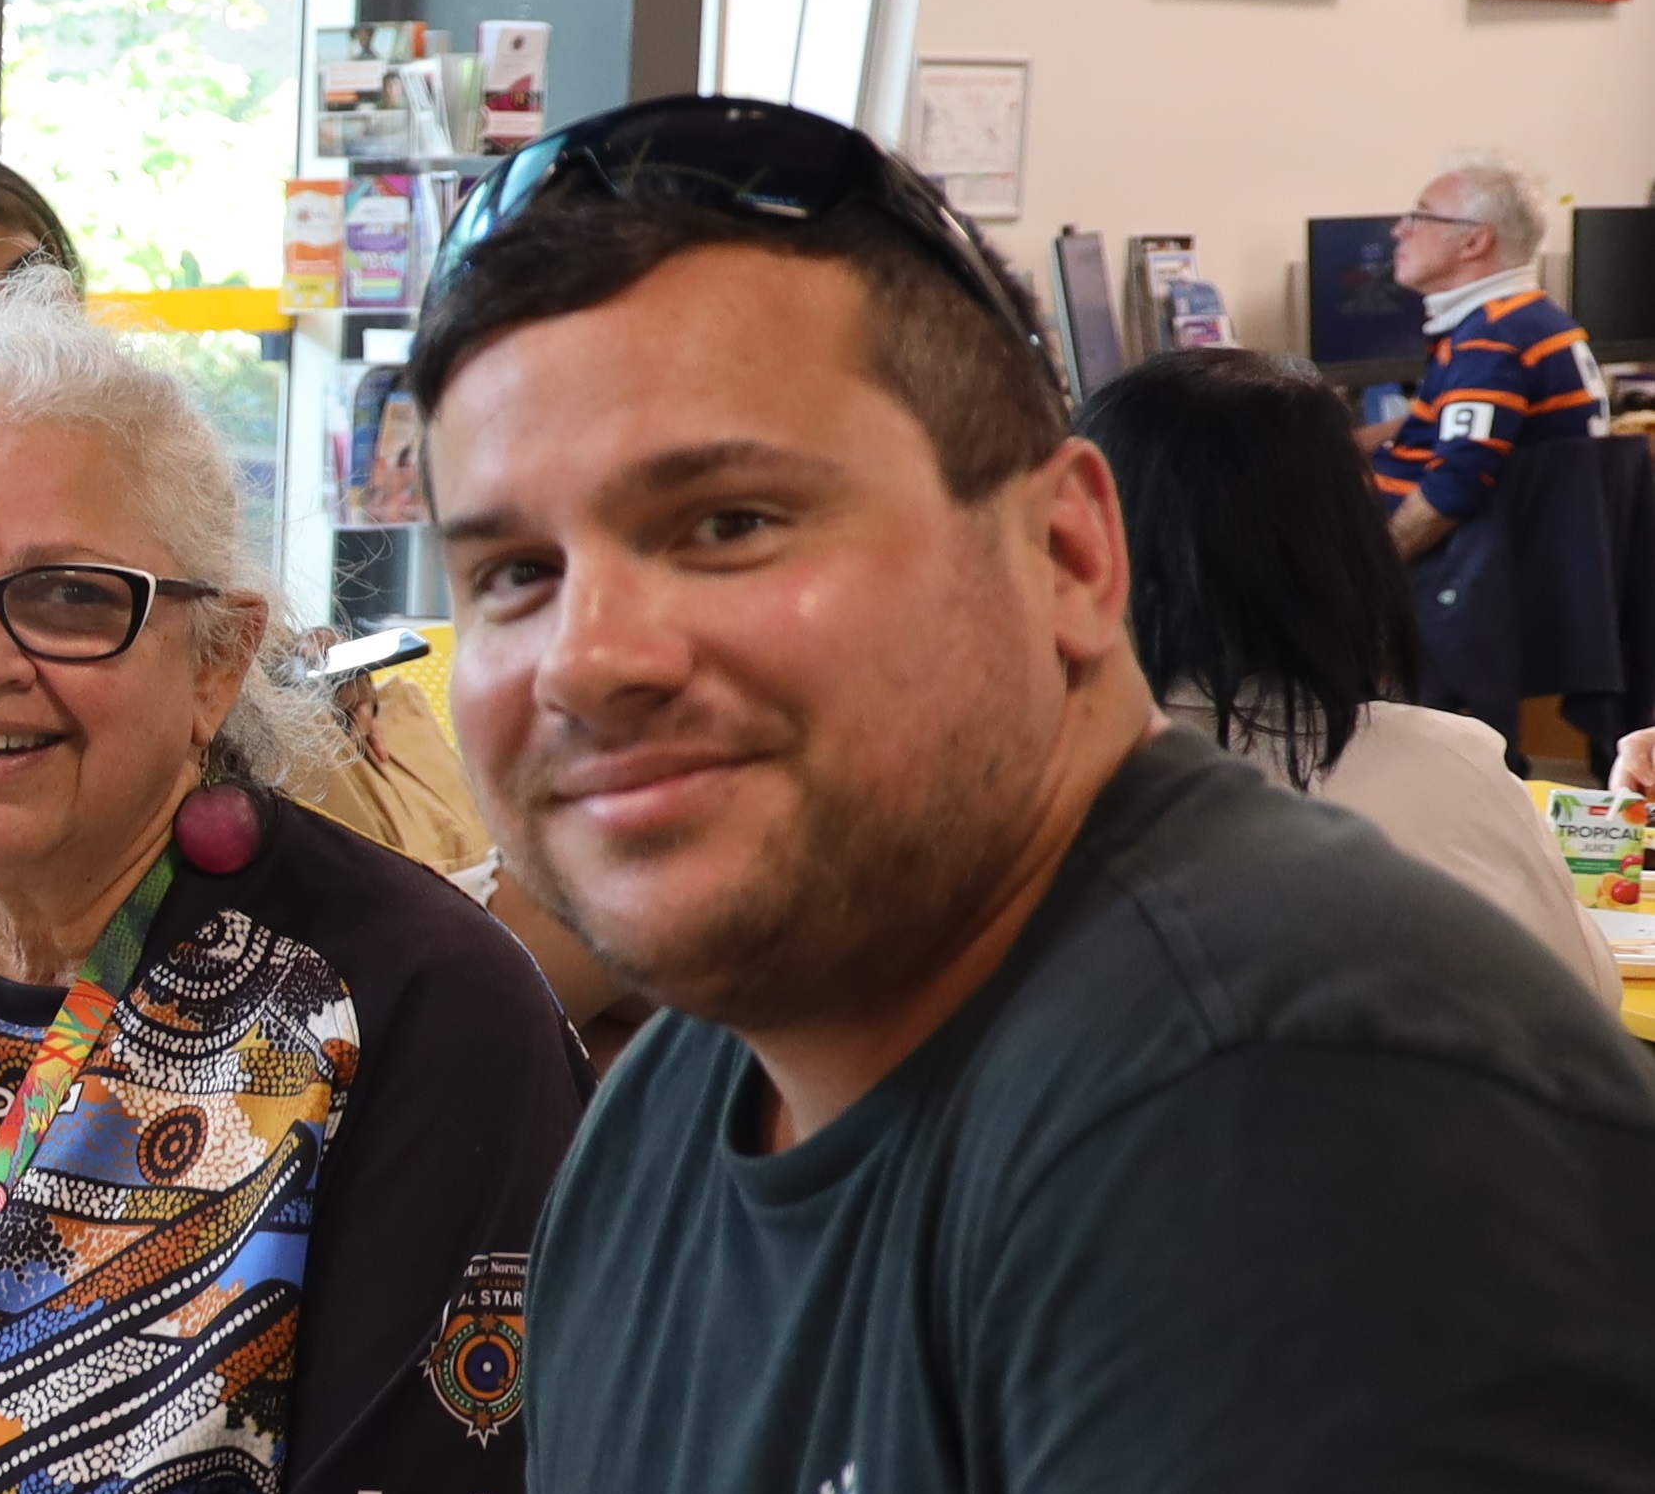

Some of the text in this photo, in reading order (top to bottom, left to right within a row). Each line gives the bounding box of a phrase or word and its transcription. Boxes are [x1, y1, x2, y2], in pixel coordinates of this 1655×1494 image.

[1558, 824, 1641, 841] TROPICAL
[1579, 843, 1617, 853] JUICE
[490, 1260, 528, 1276] Norma
[479, 1288, 524, 1308] STAR
